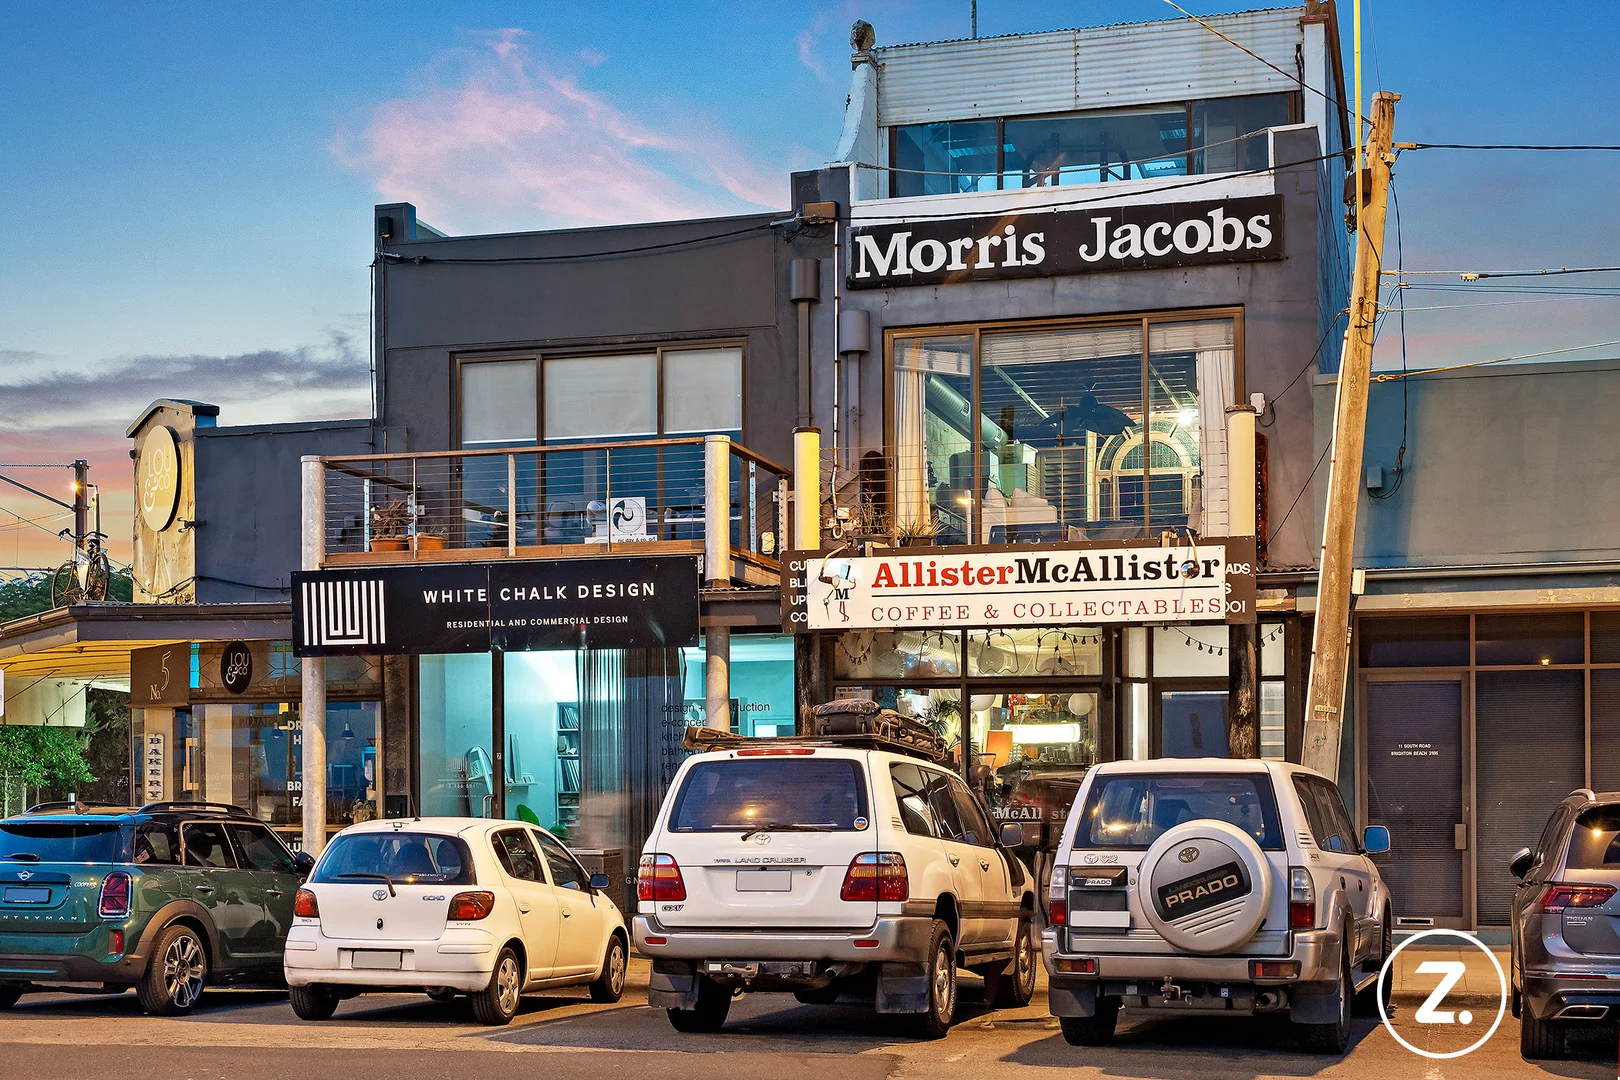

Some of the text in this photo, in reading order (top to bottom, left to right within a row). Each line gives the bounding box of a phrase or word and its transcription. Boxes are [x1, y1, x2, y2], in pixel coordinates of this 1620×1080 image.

[855, 207, 1273, 278] Morris Jacobs
[147, 445, 172, 478] LOU
[158, 473, 171, 490] CO
[423, 582, 655, 603] WHITE CHALK DESIGN
[835, 588, 850, 600] M
[871, 598, 1221, 622] COFFEE & COLLECTABLES
[446, 616, 628, 629] RESIDENTIAL AND COMMERCIAL DESIGN
[230, 653, 249, 667] LOU
[161, 651, 171, 691] 5
[238, 667, 248, 676] CO
[661, 702, 695, 714] design
[148, 737, 162, 798] BAKERY
[1165, 874, 1239, 909] PRADO
